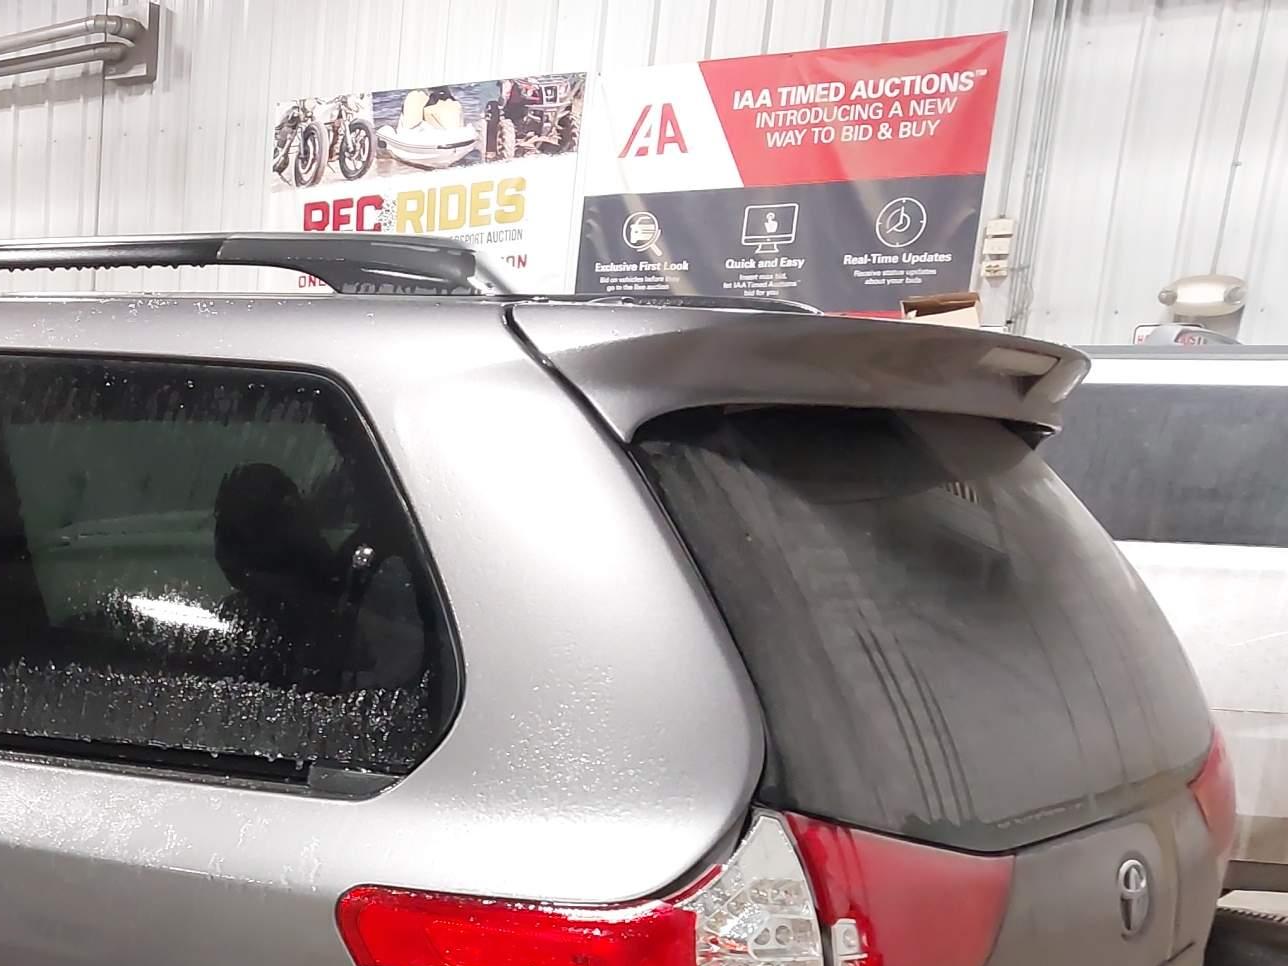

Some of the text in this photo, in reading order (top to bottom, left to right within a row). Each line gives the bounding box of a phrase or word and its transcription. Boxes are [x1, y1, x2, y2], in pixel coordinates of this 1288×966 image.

[733, 88, 772, 110] IAA
[777, 81, 845, 106] TIMED
[755, 97, 958, 129] INTRODUCING A NEW
[766, 119, 941, 148] WAY TO BID & BUY
[303, 176, 527, 233] REC RIDES
[486, 228, 524, 244] AUCTION
[595, 260, 689, 272] Exclusive First Look
[725, 257, 805, 269] Quick and Easy
[843, 252, 952, 265] Real-Time Updates
